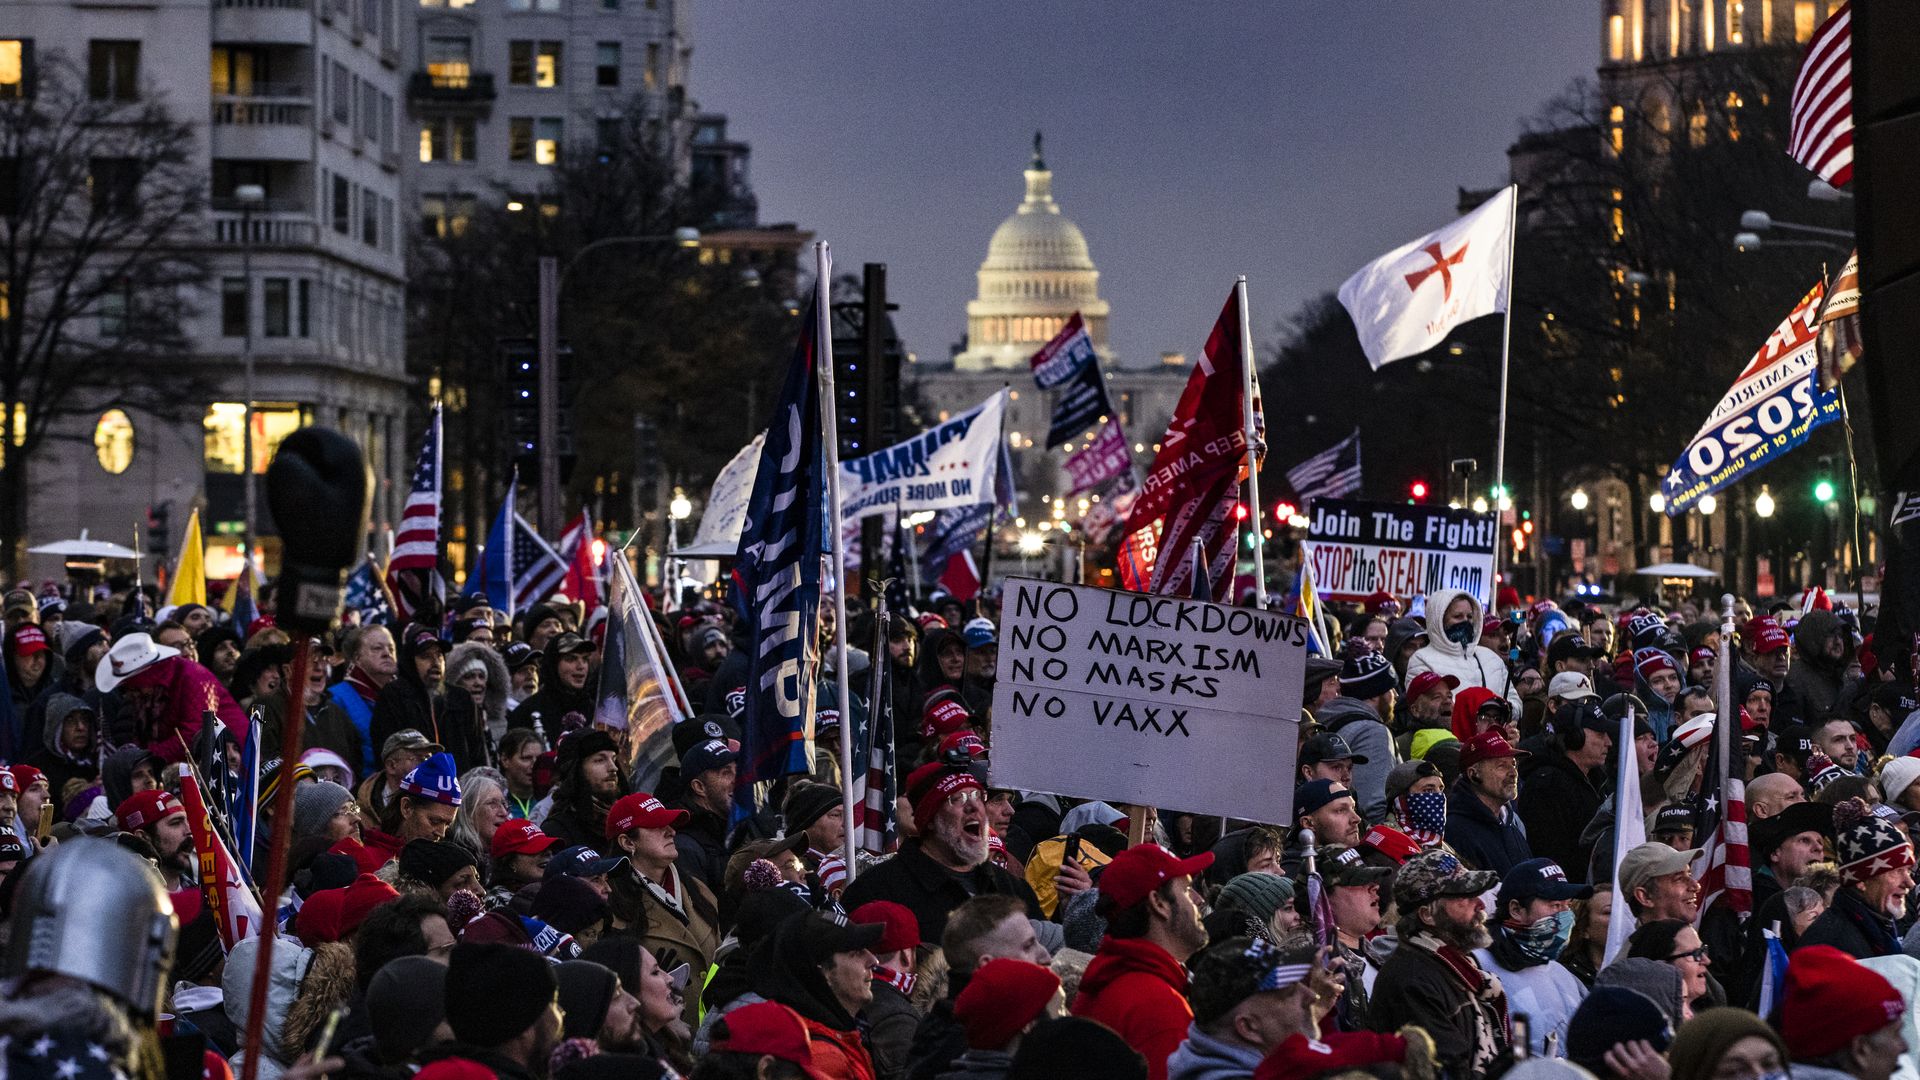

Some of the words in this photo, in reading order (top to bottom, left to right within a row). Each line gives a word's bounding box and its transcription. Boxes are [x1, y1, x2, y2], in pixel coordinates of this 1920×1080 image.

[1310, 507, 1361, 538] Join
[1372, 511, 1415, 542] The
[1425, 515, 1495, 550] Fight!
[1016, 585, 1079, 622] NO
[1106, 591, 1309, 647] LOCKDOWNS
[1011, 625, 1067, 653] NO
[1087, 630, 1261, 679] MARXISM
[1012, 657, 1068, 682] NO
[1085, 661, 1220, 698] MASKS
[1577, 678, 1589, 688] A
[1013, 690, 1067, 718] NO
[1093, 699, 1190, 738] VAXX
[943, 778, 967, 792] GREAT
[1661, 808, 1691, 818] TRUMP
